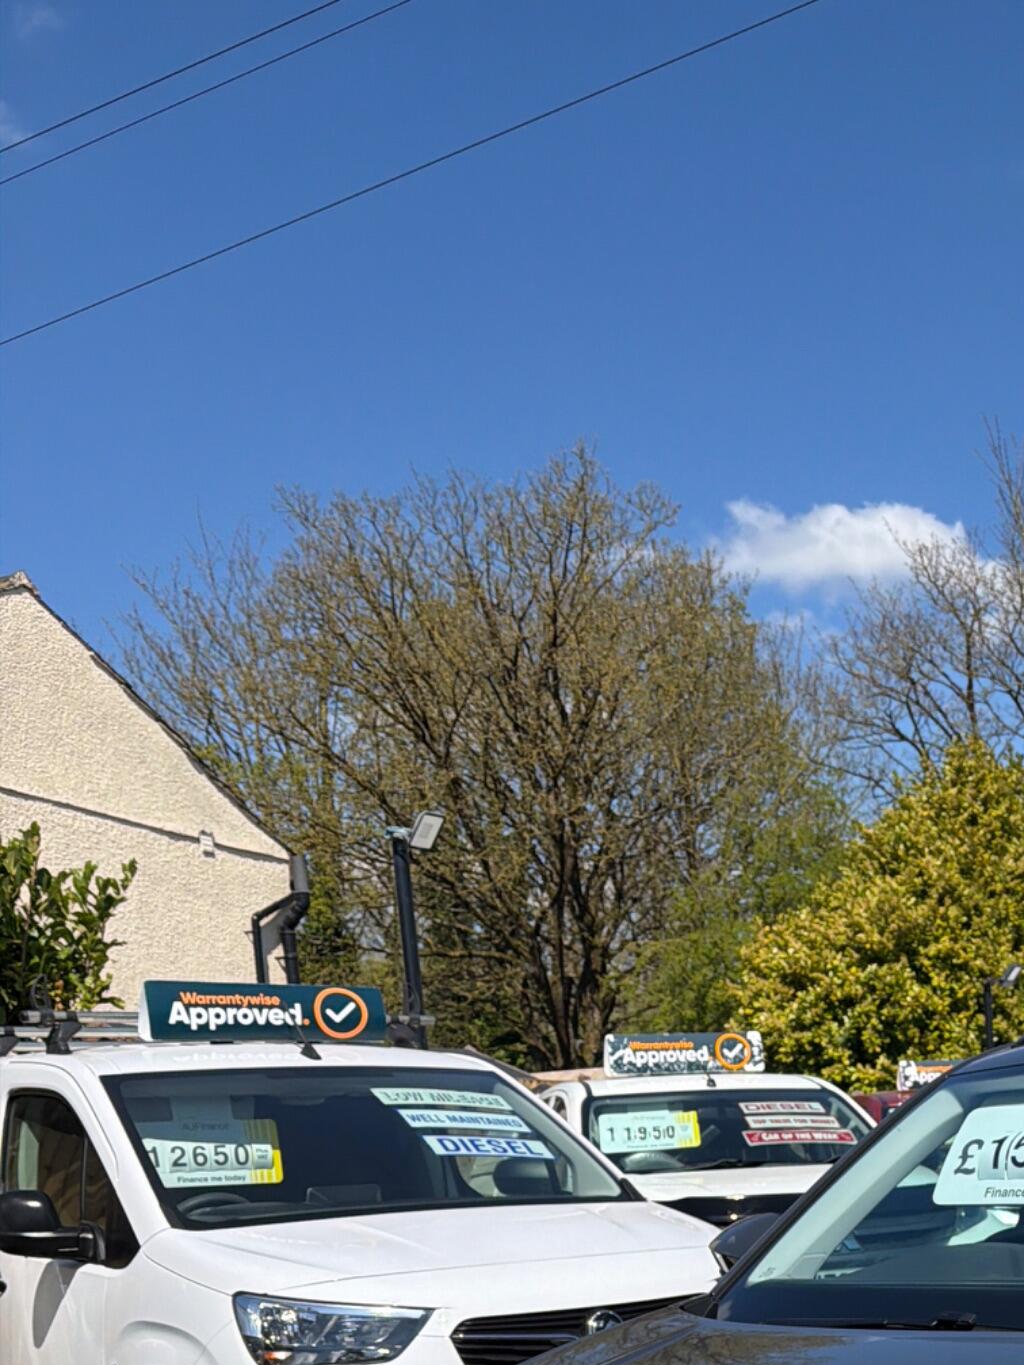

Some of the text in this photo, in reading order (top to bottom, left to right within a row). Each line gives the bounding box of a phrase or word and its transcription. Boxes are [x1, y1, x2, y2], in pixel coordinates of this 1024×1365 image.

[179, 991, 281, 1007] Warrantywise
[168, 1001, 310, 1031] Approved.
[407, 1113, 523, 1128] WELL MAINTAINED
[438, 1137, 544, 1156] DIESEL
